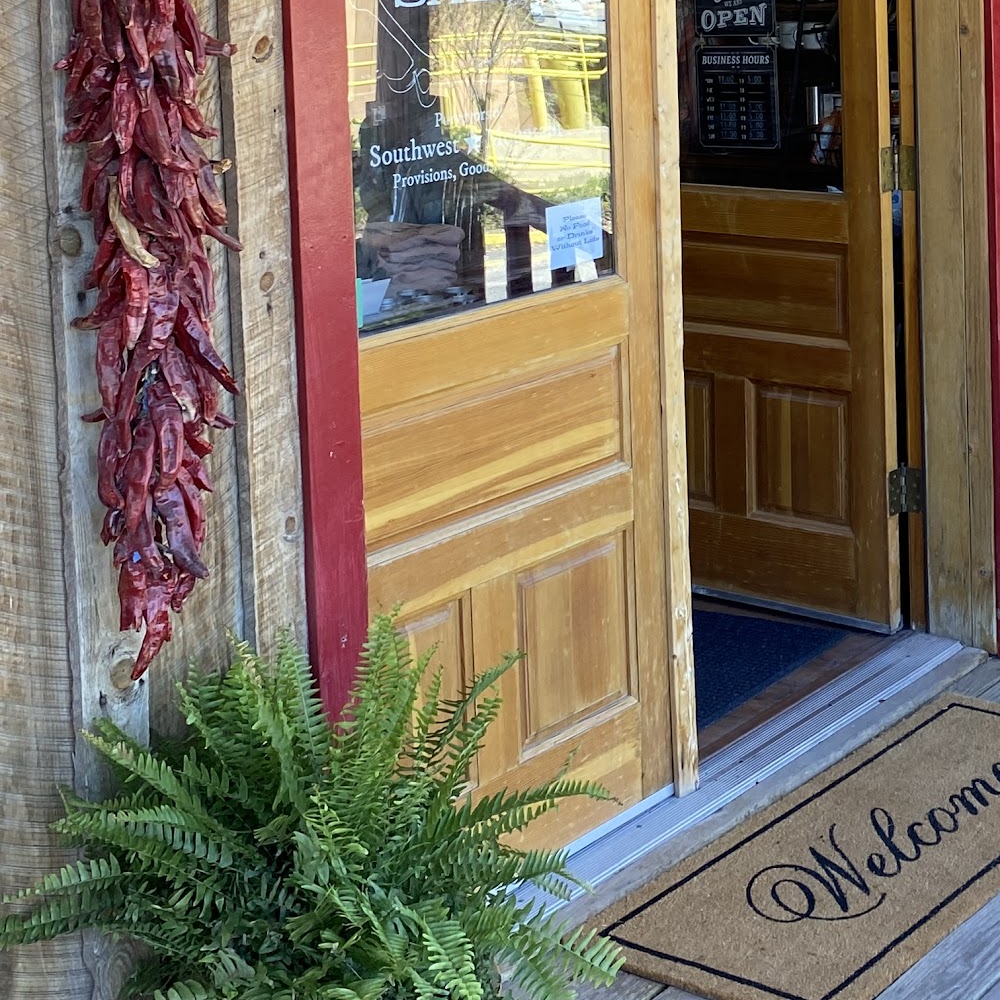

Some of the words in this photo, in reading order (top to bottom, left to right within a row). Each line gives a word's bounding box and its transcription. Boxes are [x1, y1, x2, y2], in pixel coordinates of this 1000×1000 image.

[701, 2, 768, 32] OPEN
[702, 55, 741, 65] BUSINESS
[742, 55, 770, 65] HOURS
[370, 137, 460, 168] Southwest
[392, 166, 457, 189] Provisions,
[560, 224, 571, 233] No
[572, 220, 591, 230] Food
[567, 229, 594, 240] Drinks
[550, 240, 582, 252] Without
[583, 235, 600, 245] Lids
